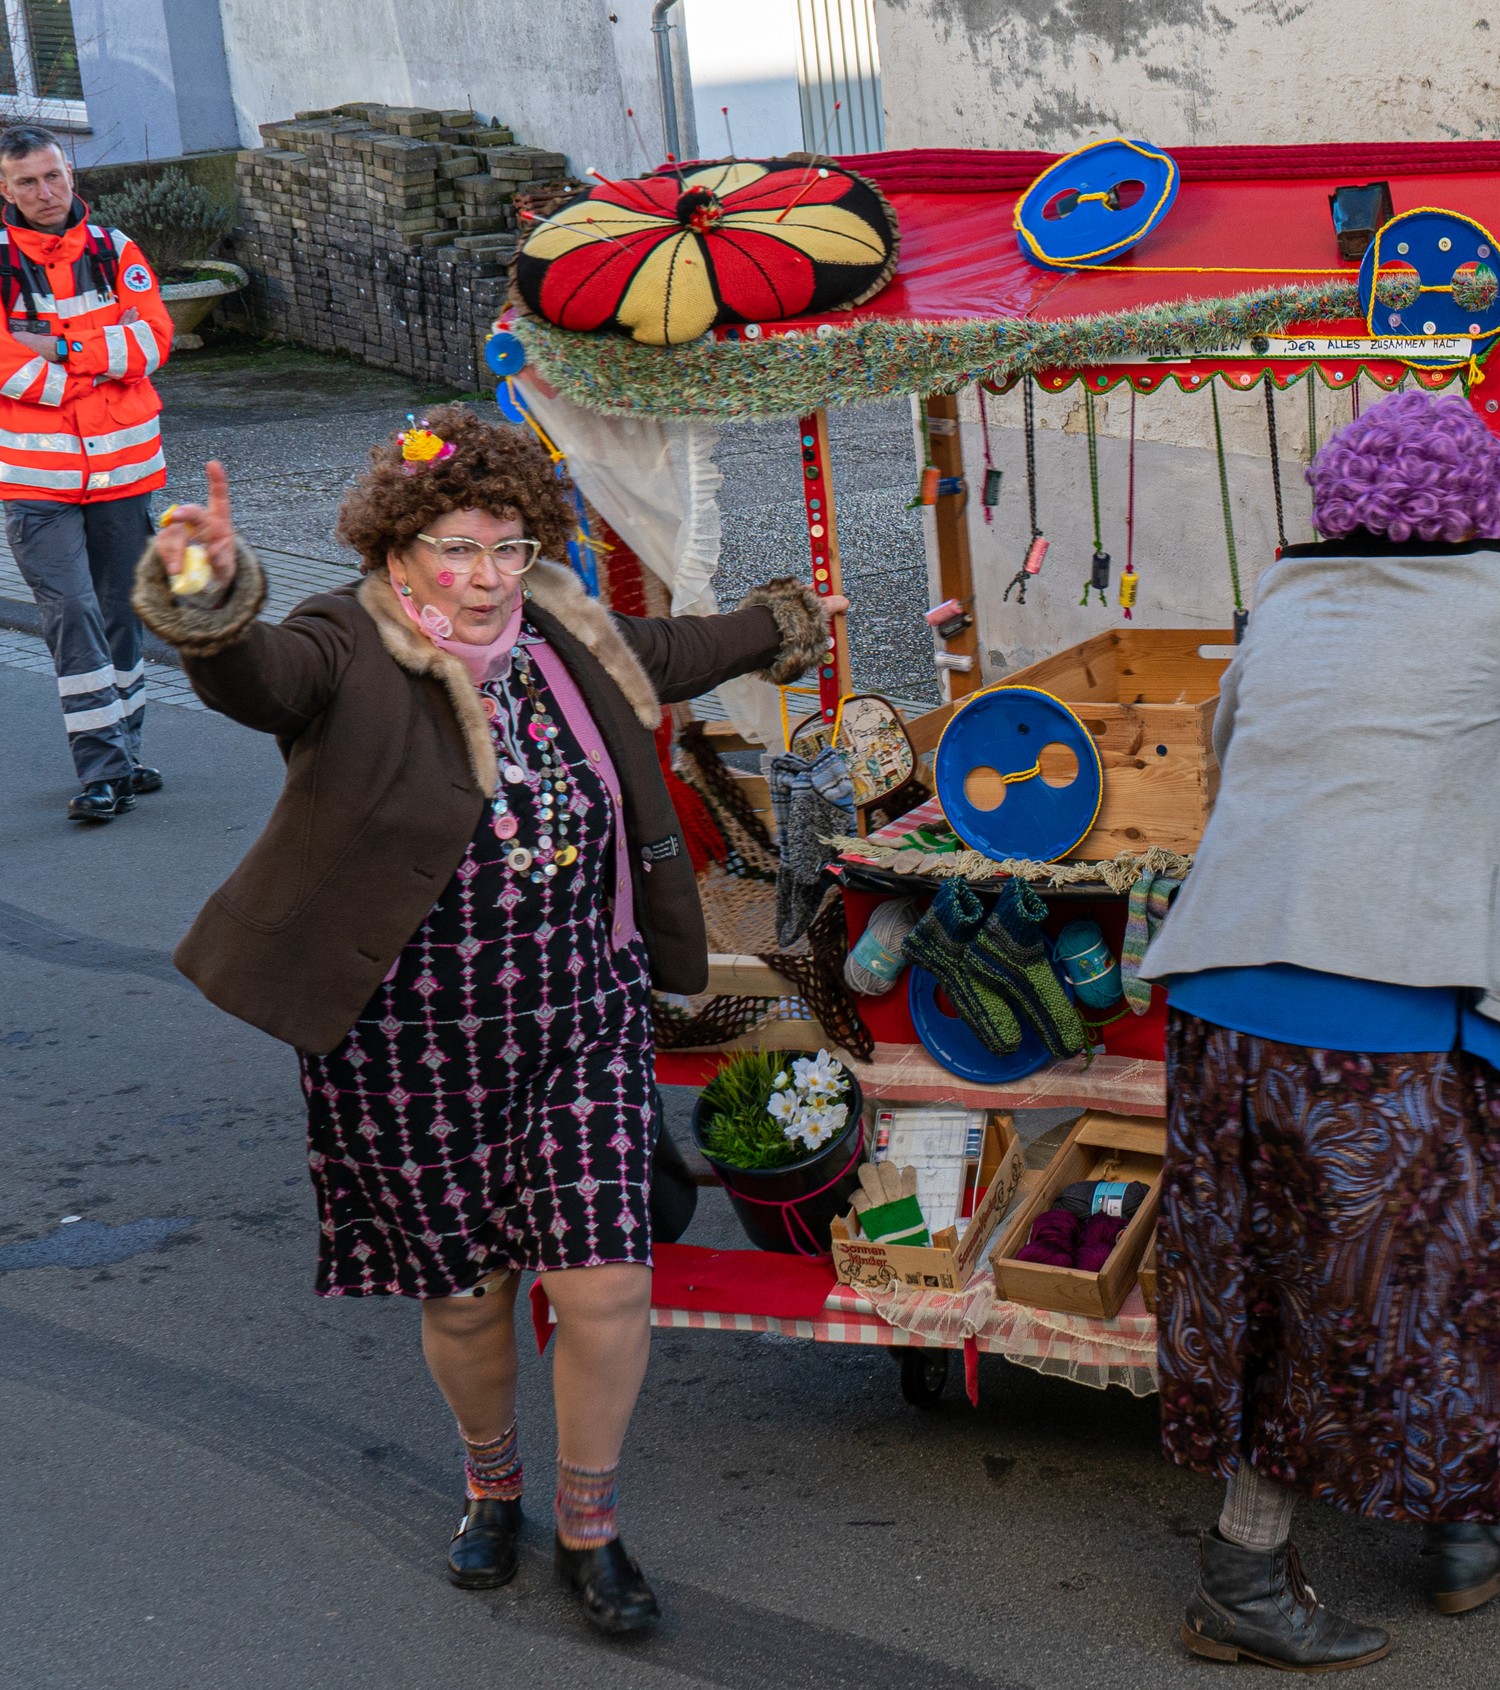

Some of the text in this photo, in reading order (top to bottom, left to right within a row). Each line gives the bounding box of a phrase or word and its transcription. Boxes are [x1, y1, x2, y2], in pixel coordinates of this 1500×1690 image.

[1327, 339, 1361, 350] ALLES
[1370, 338, 1426, 350] ZUSAMMEN
[840, 1243, 886, 1256] Sonnen
